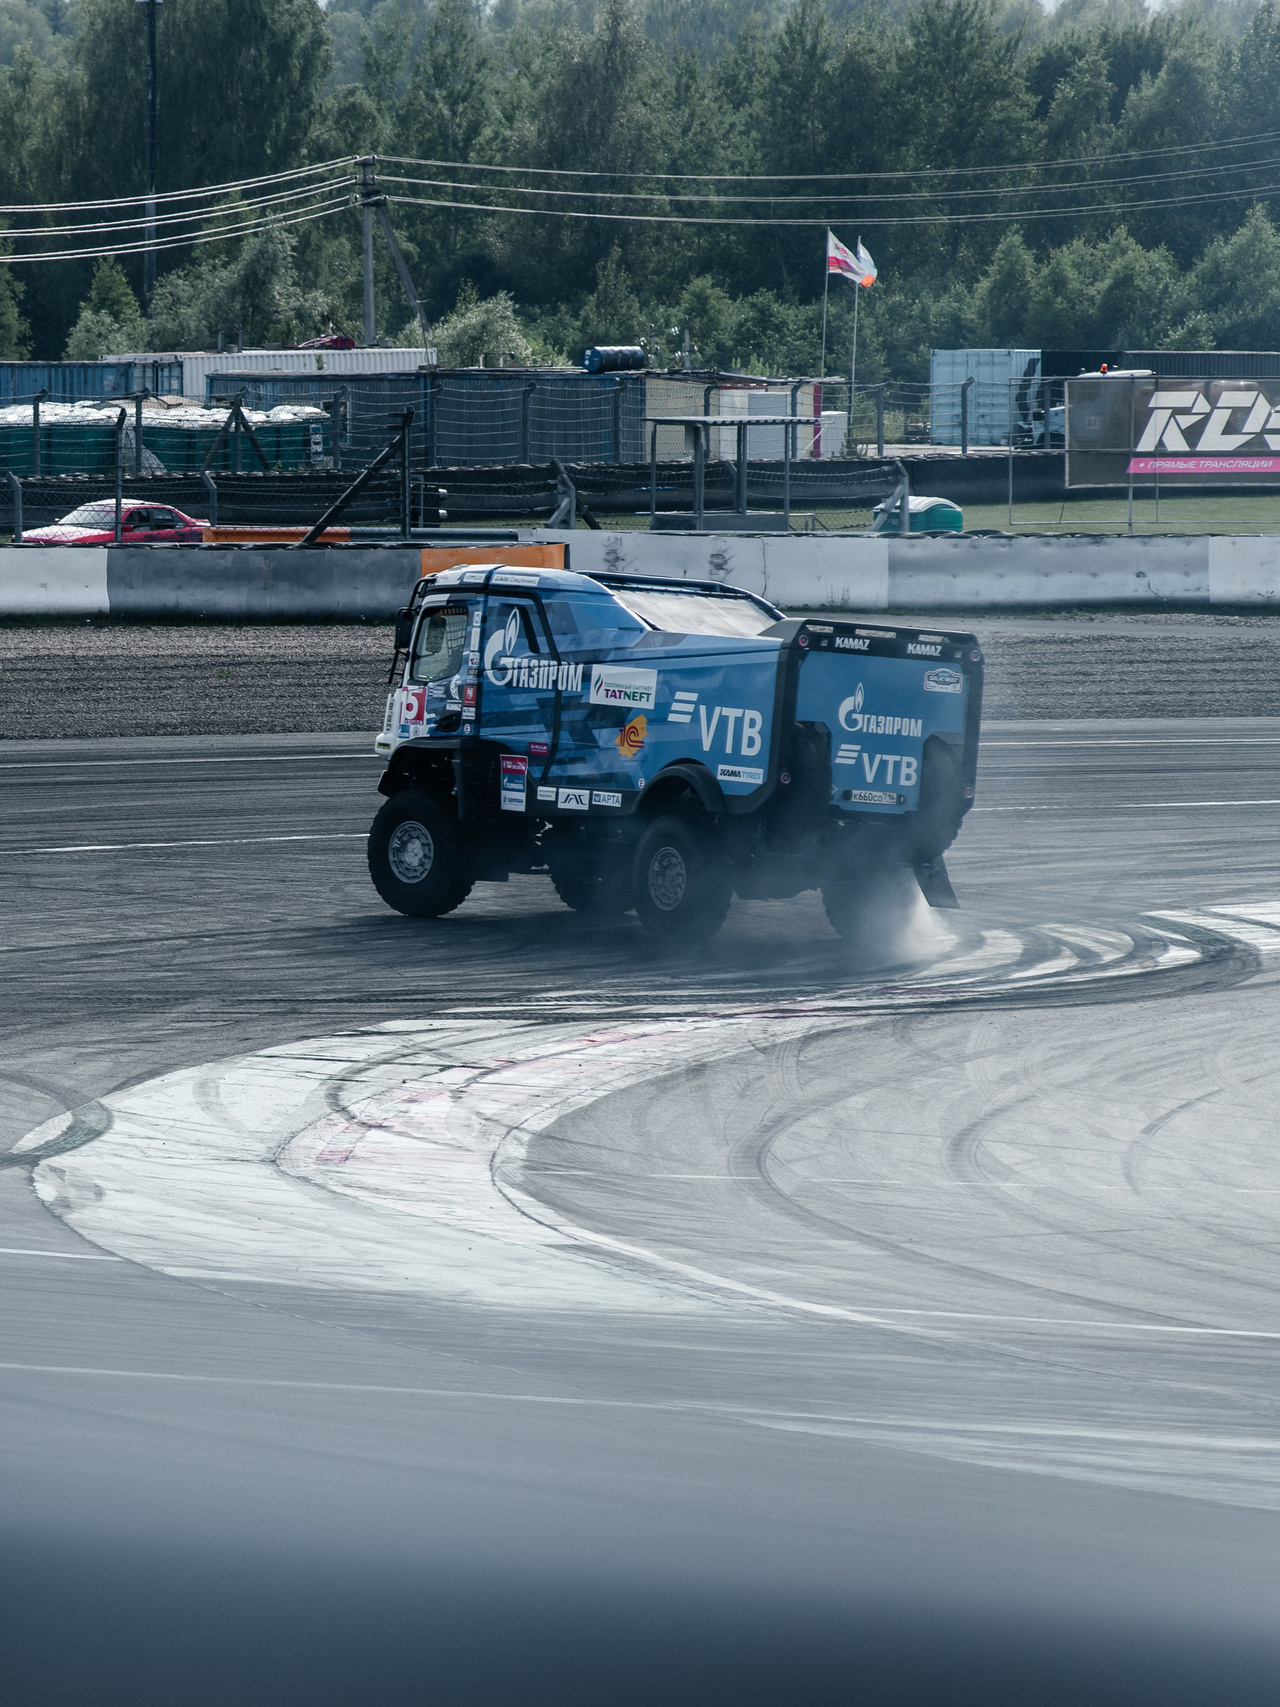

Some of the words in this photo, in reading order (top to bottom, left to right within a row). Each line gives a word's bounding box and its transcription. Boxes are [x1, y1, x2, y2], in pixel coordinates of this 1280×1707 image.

[1135, 390, 1280, 451] RD
[1147, 460, 1197, 469] ПРЯМЫЕ
[1199, 460, 1273, 469] ТРАНСЛЯЦИИ
[835, 637, 870, 650] KAMAZ
[907, 643, 942, 656] KAMAZ
[512, 658, 584, 692] ГАЗПРОМ
[604, 688, 652, 702] TATNEFT
[699, 704, 763, 756] VTB
[863, 714, 923, 737] ГАЗПРОМ
[862, 753, 918, 786] VTB
